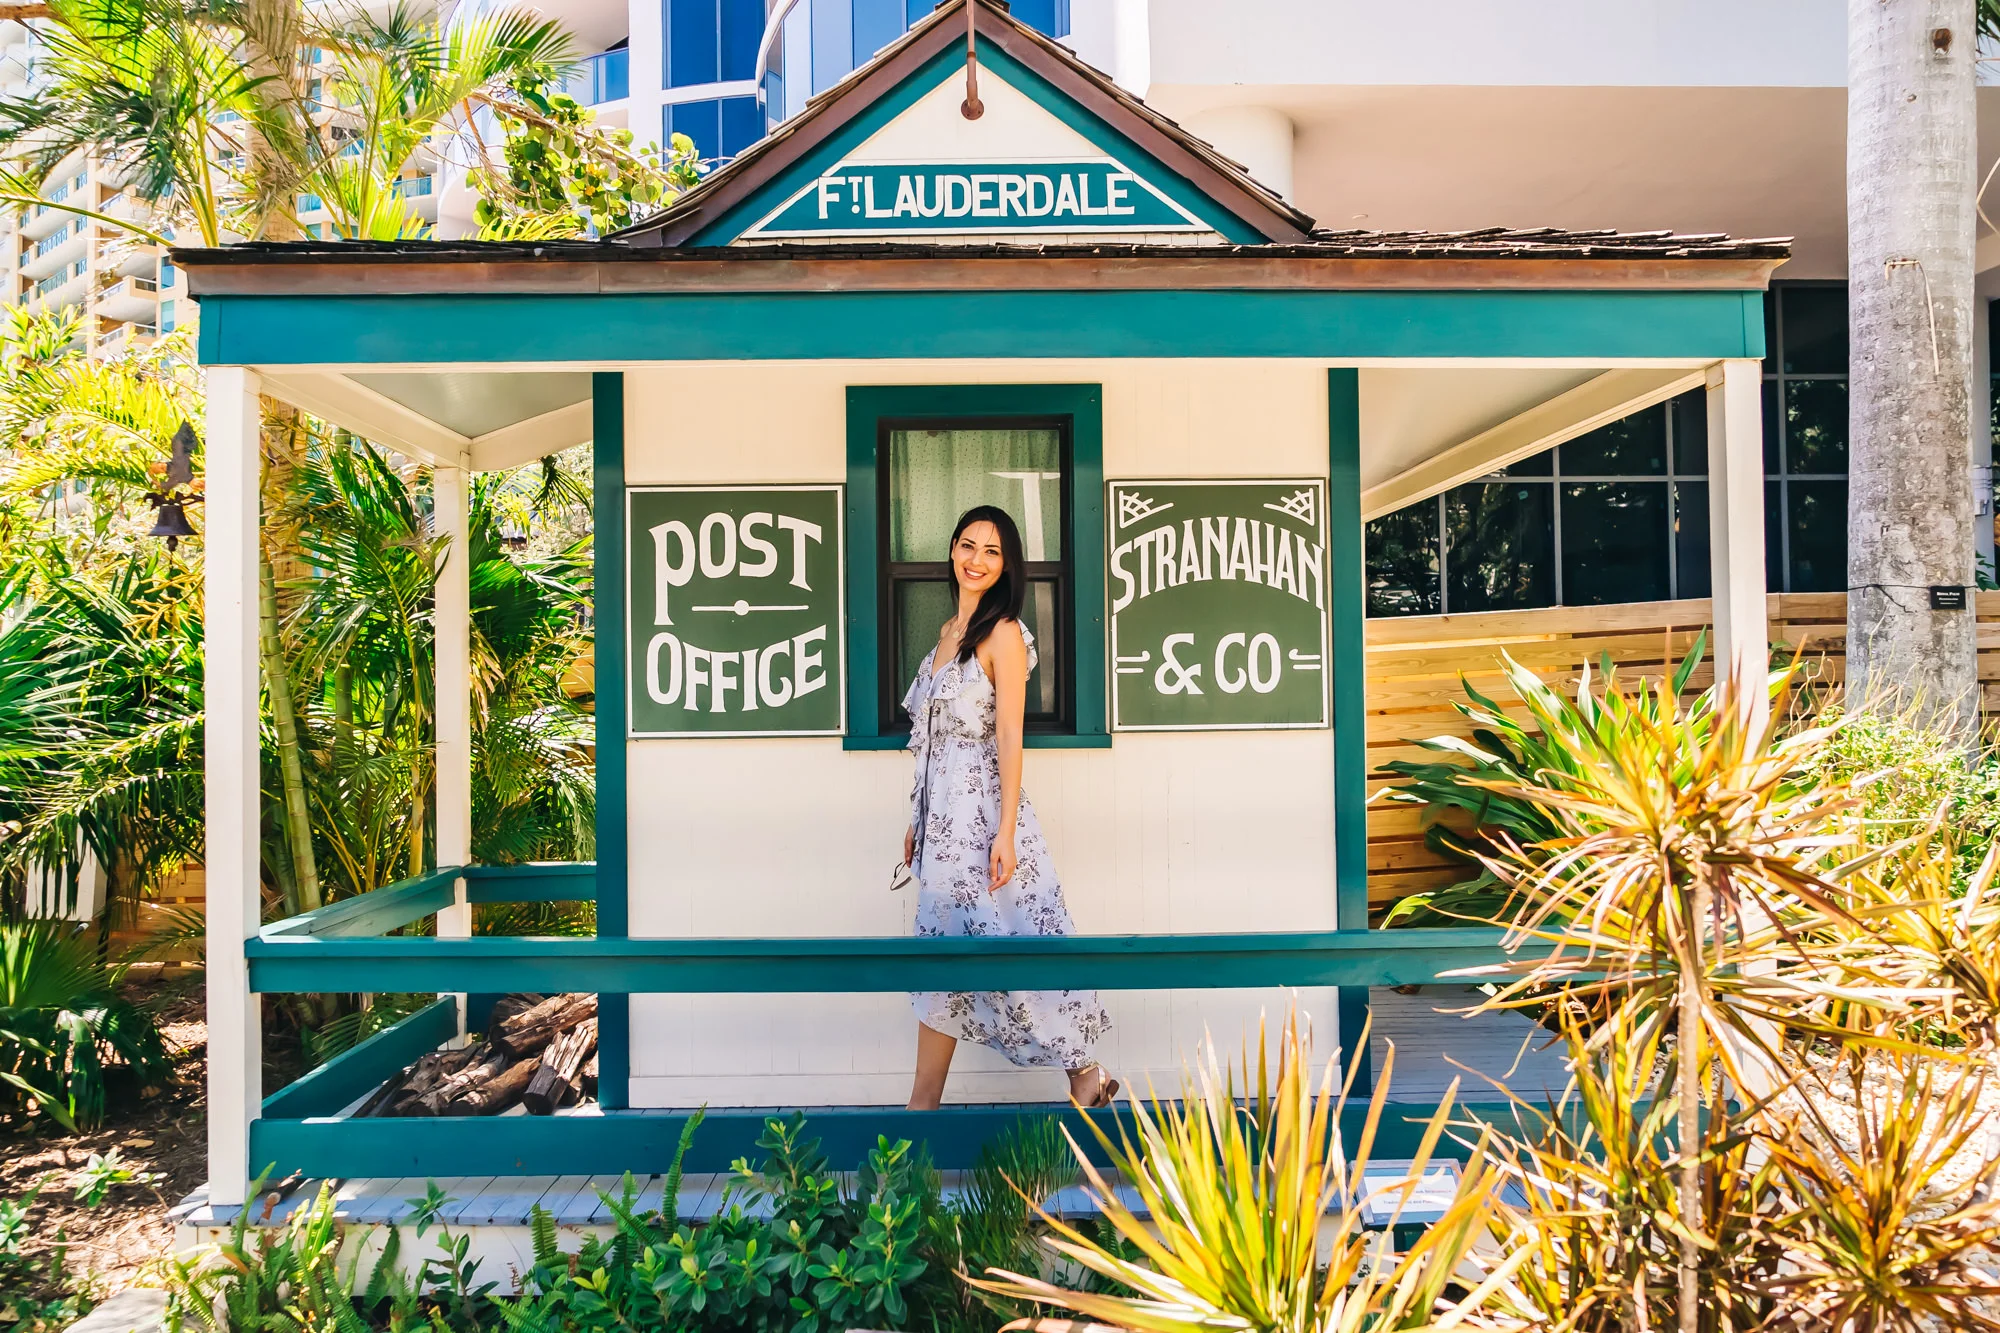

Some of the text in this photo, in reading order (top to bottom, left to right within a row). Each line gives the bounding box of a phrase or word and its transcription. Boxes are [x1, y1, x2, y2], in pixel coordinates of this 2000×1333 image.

[864, 173, 1135, 218] LAUDERDALE
[648, 512, 822, 625] POST
[1110, 516, 1325, 615] STRANAHAN
[646, 624, 827, 713] OFFICE
[1154, 632, 1282, 695] & CO
